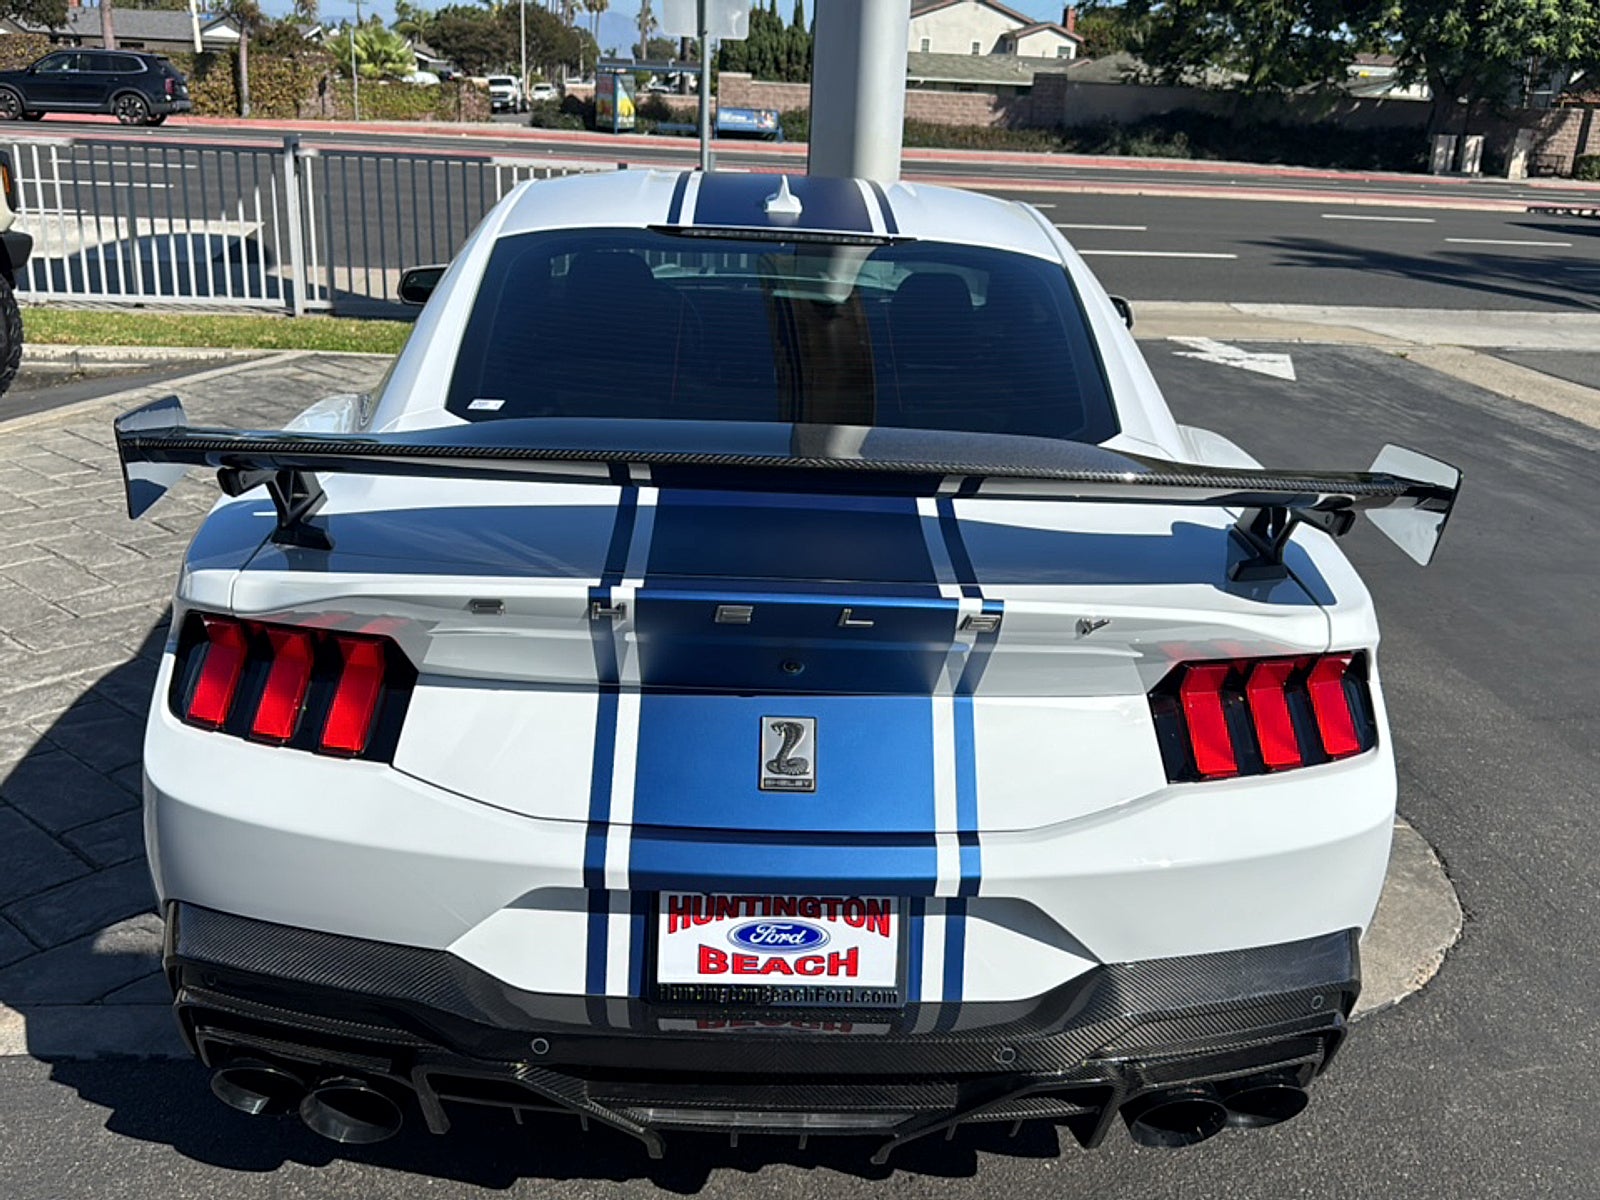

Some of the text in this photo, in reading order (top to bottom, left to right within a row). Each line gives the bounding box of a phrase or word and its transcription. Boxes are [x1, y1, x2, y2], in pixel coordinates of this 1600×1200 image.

[471, 599, 1110, 637] SHELBY
[668, 894, 891, 938] HUNTINGTON
[749, 924, 807, 944] Ford
[698, 943, 859, 977] BEACH
[659, 985, 898, 1005] HuntingtonBeachFord.com
